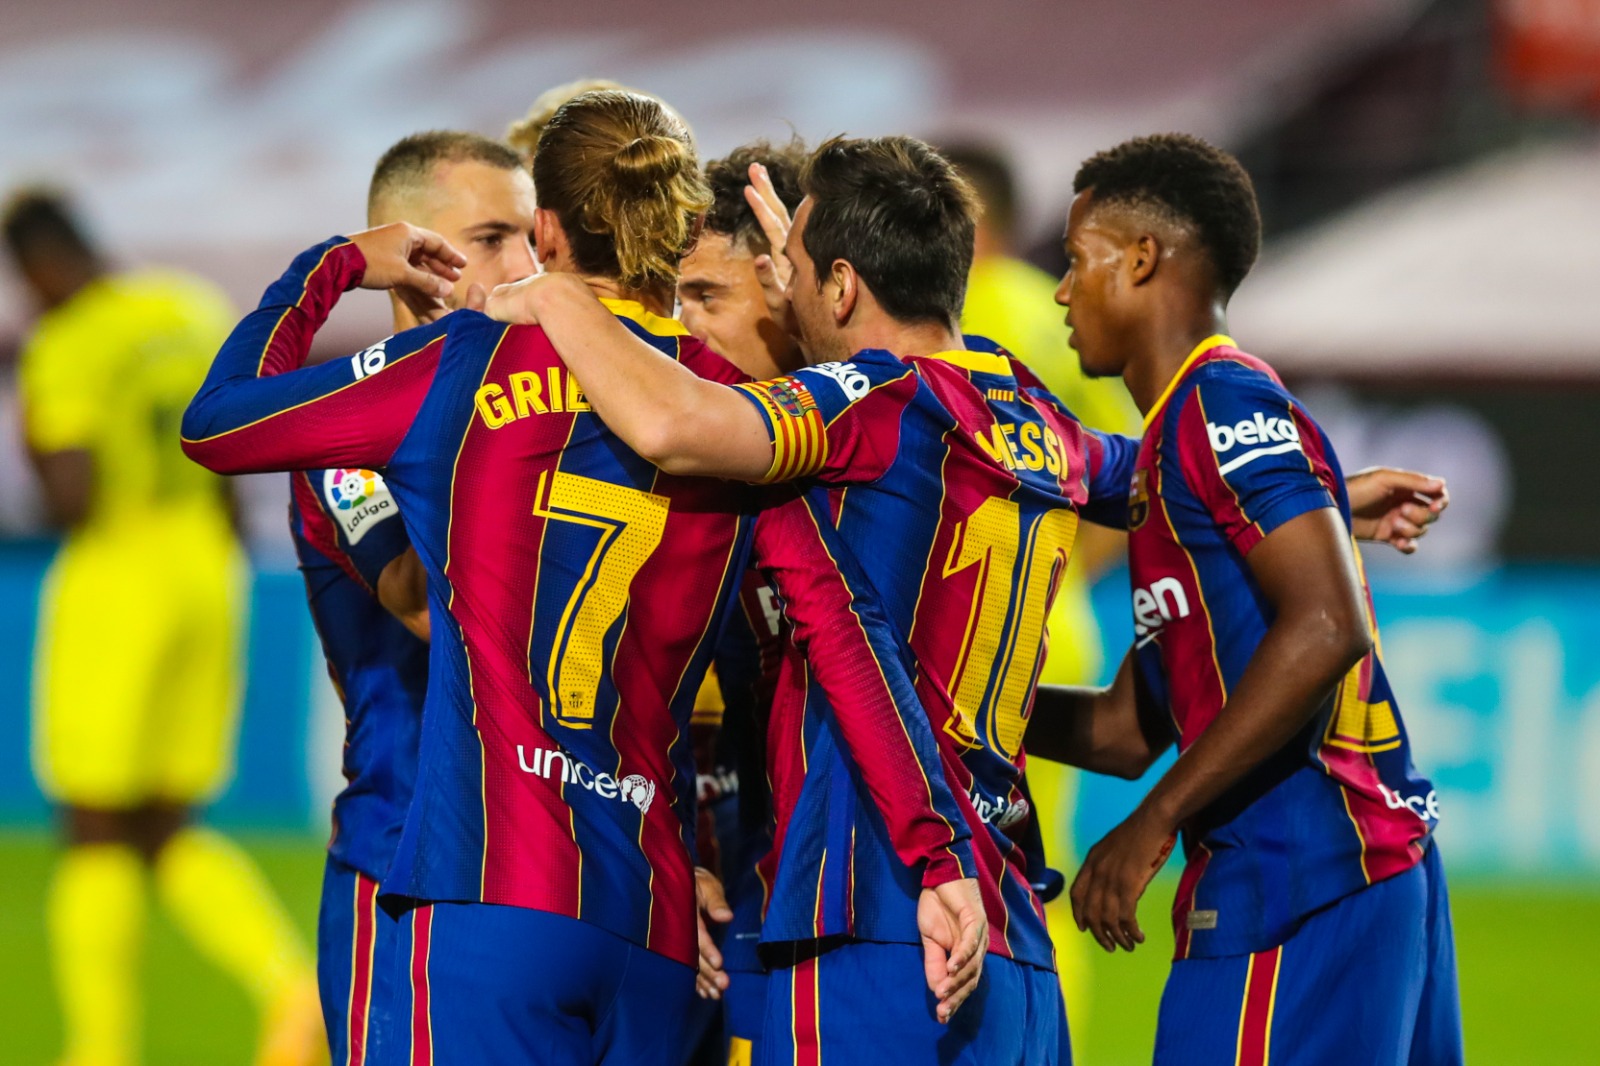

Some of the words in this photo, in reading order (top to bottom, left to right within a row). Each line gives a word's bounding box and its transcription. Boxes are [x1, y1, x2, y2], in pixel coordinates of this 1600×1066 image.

[363, 335, 395, 377] ko
[815, 361, 871, 399] eko
[474, 366, 592, 430] GRIE
[974, 421, 1069, 481] MESSI
[1206, 411, 1300, 453] beko
[346, 499, 390, 533] LaLiga
[533, 470, 670, 730] 7
[1133, 576, 1190, 628] en
[942, 495, 1078, 763] 10
[517, 744, 618, 799] unice
